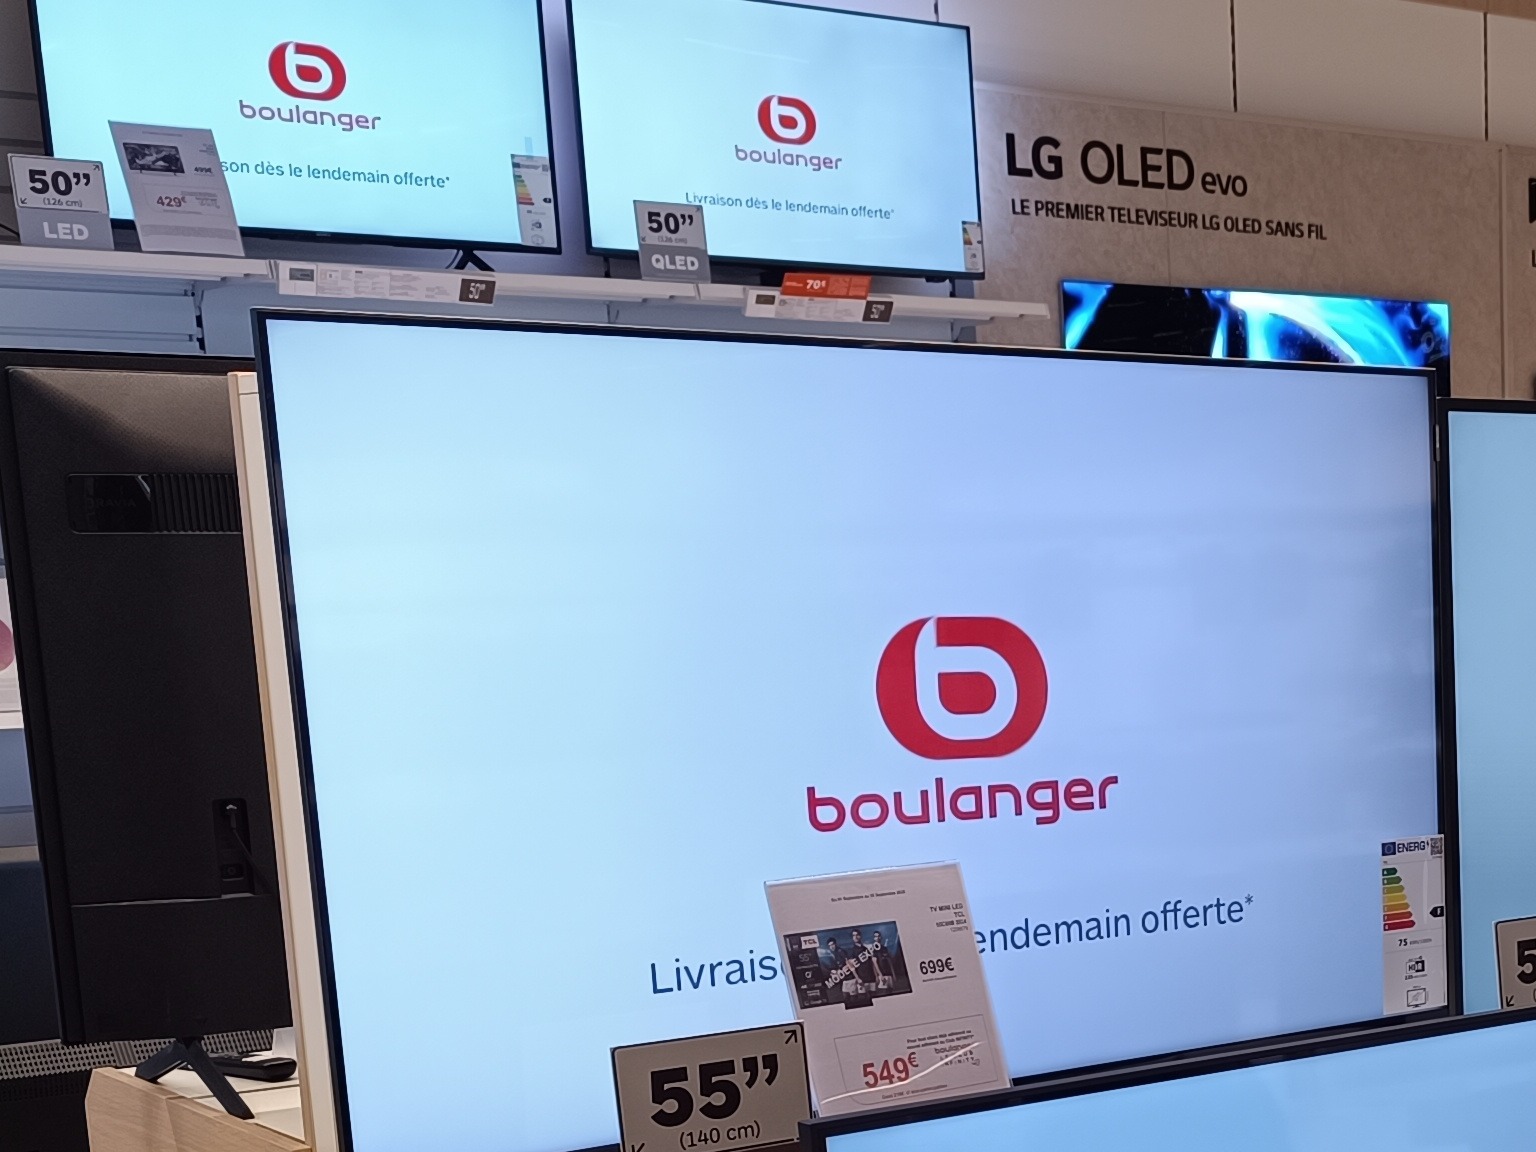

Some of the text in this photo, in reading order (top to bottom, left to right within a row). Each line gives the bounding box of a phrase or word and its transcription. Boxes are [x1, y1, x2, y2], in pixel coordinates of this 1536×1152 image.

[238, 99, 381, 131] boulanger
[254, 160, 285, 177] dès
[289, 163, 302, 177] le
[307, 164, 390, 184] lendemain
[734, 144, 843, 172] boulanger
[1005, 132, 1248, 198] LG OLED evo
[685, 191, 743, 209] Livraison
[745, 195, 769, 211] dès
[771, 198, 782, 212] le
[785, 199, 849, 217] lendemain
[42, 221, 90, 241] LED
[1011, 197, 1328, 241] LE PREMIER TELEVISEUR LG OLED SANS FIL
[651, 254, 699, 270] QLED
[805, 774, 1119, 832] boulanger
[649, 949, 783, 995] Livrais
[974, 909, 1131, 956] endemain
[1398, 938, 1408, 947] 75
[919, 957, 955, 975] 699€
[862, 1052, 919, 1088] 549€
[679, 1120, 761, 1150] (140 cm)
